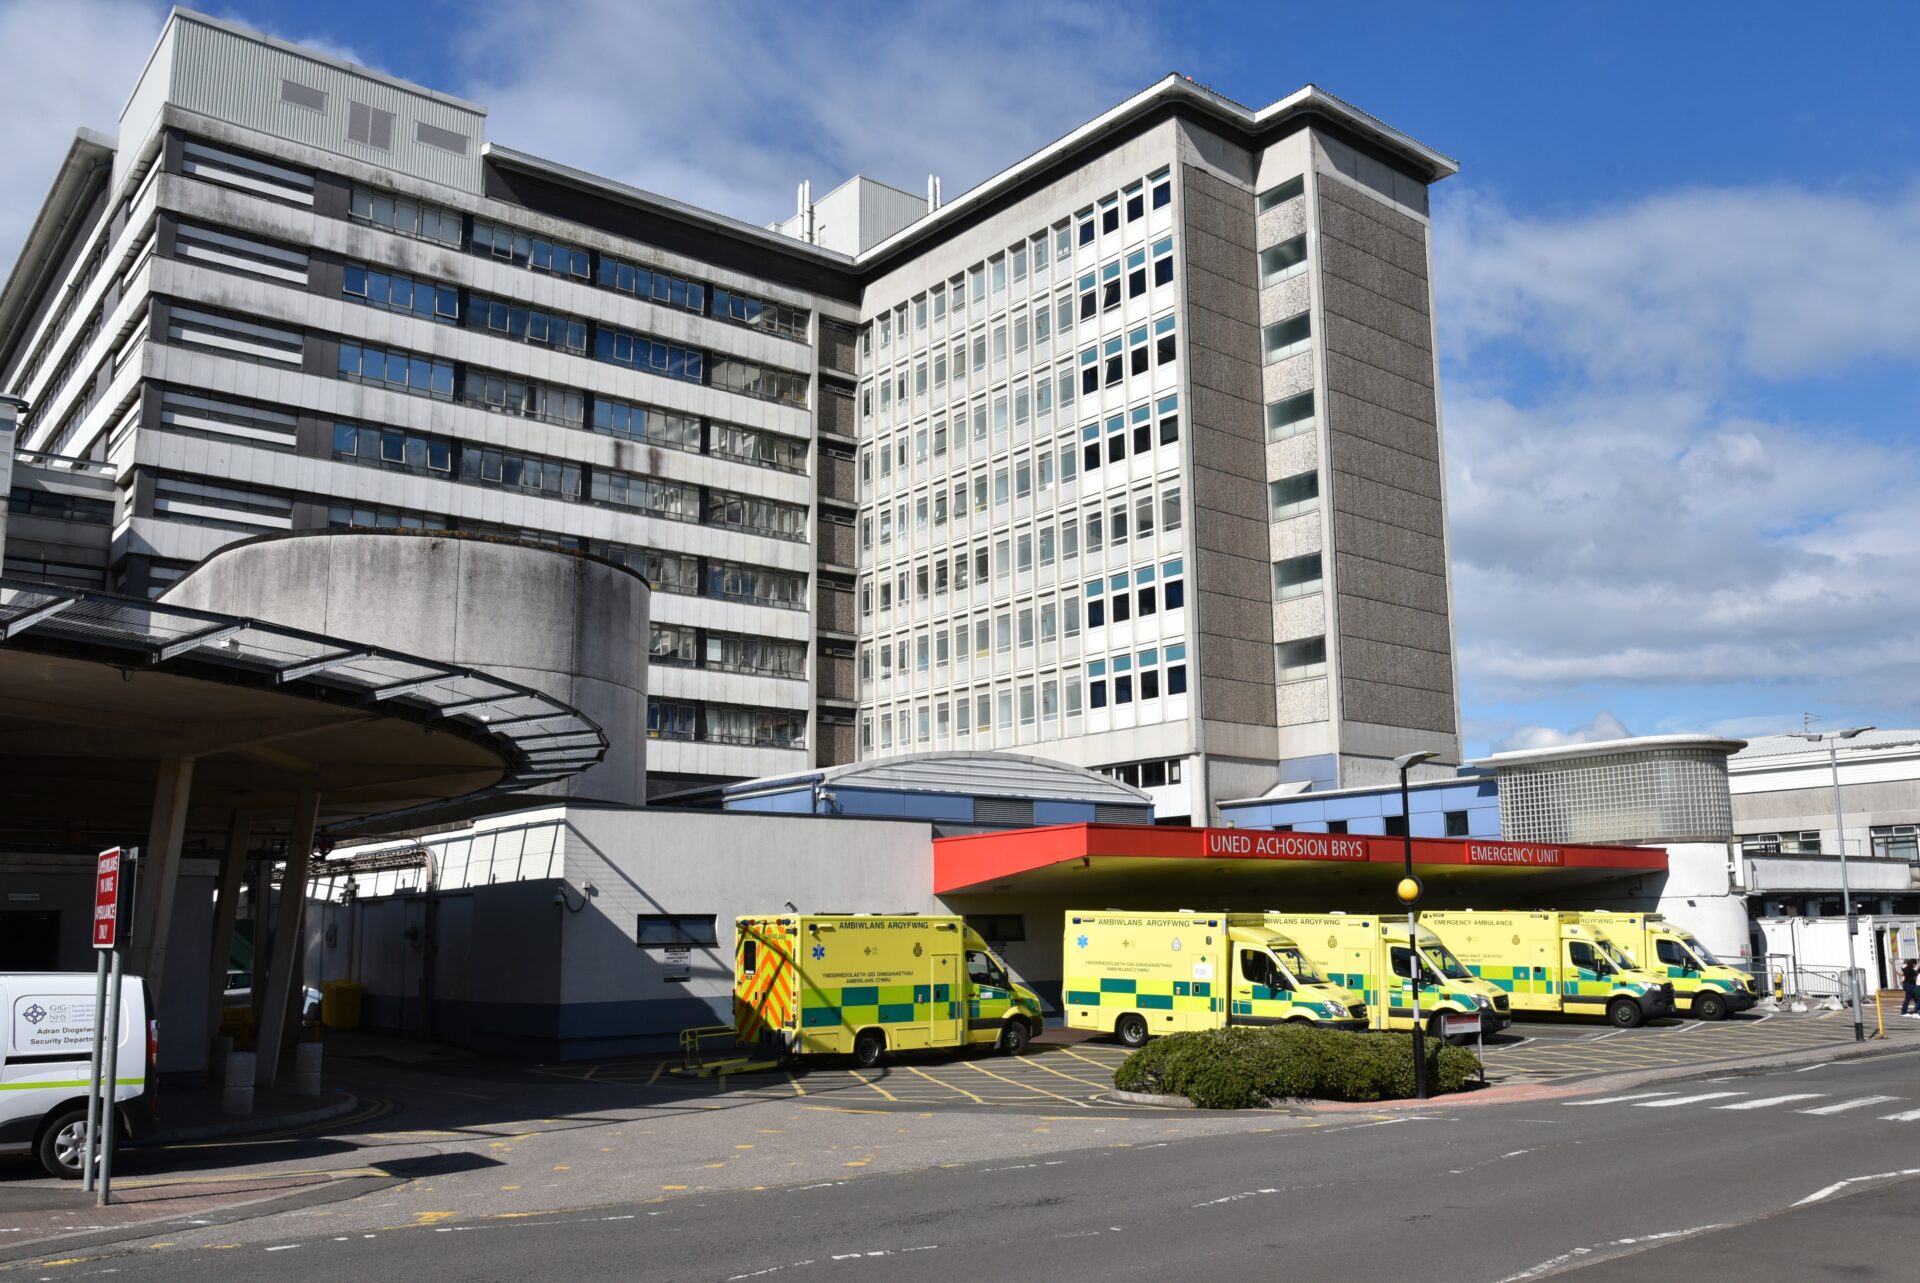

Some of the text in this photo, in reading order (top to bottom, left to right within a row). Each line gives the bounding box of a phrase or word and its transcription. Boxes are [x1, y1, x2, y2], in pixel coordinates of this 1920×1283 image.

[1211, 835, 1363, 857] UNED ACHOSION BRYS
[1471, 845, 1559, 863] EMERGENCY UNIT
[887, 921, 929, 929] ARGYFWNG
[1098, 918, 1190, 927] AMBIWLANS ARGYFWNG
[30, 1038, 61, 1046] Security
